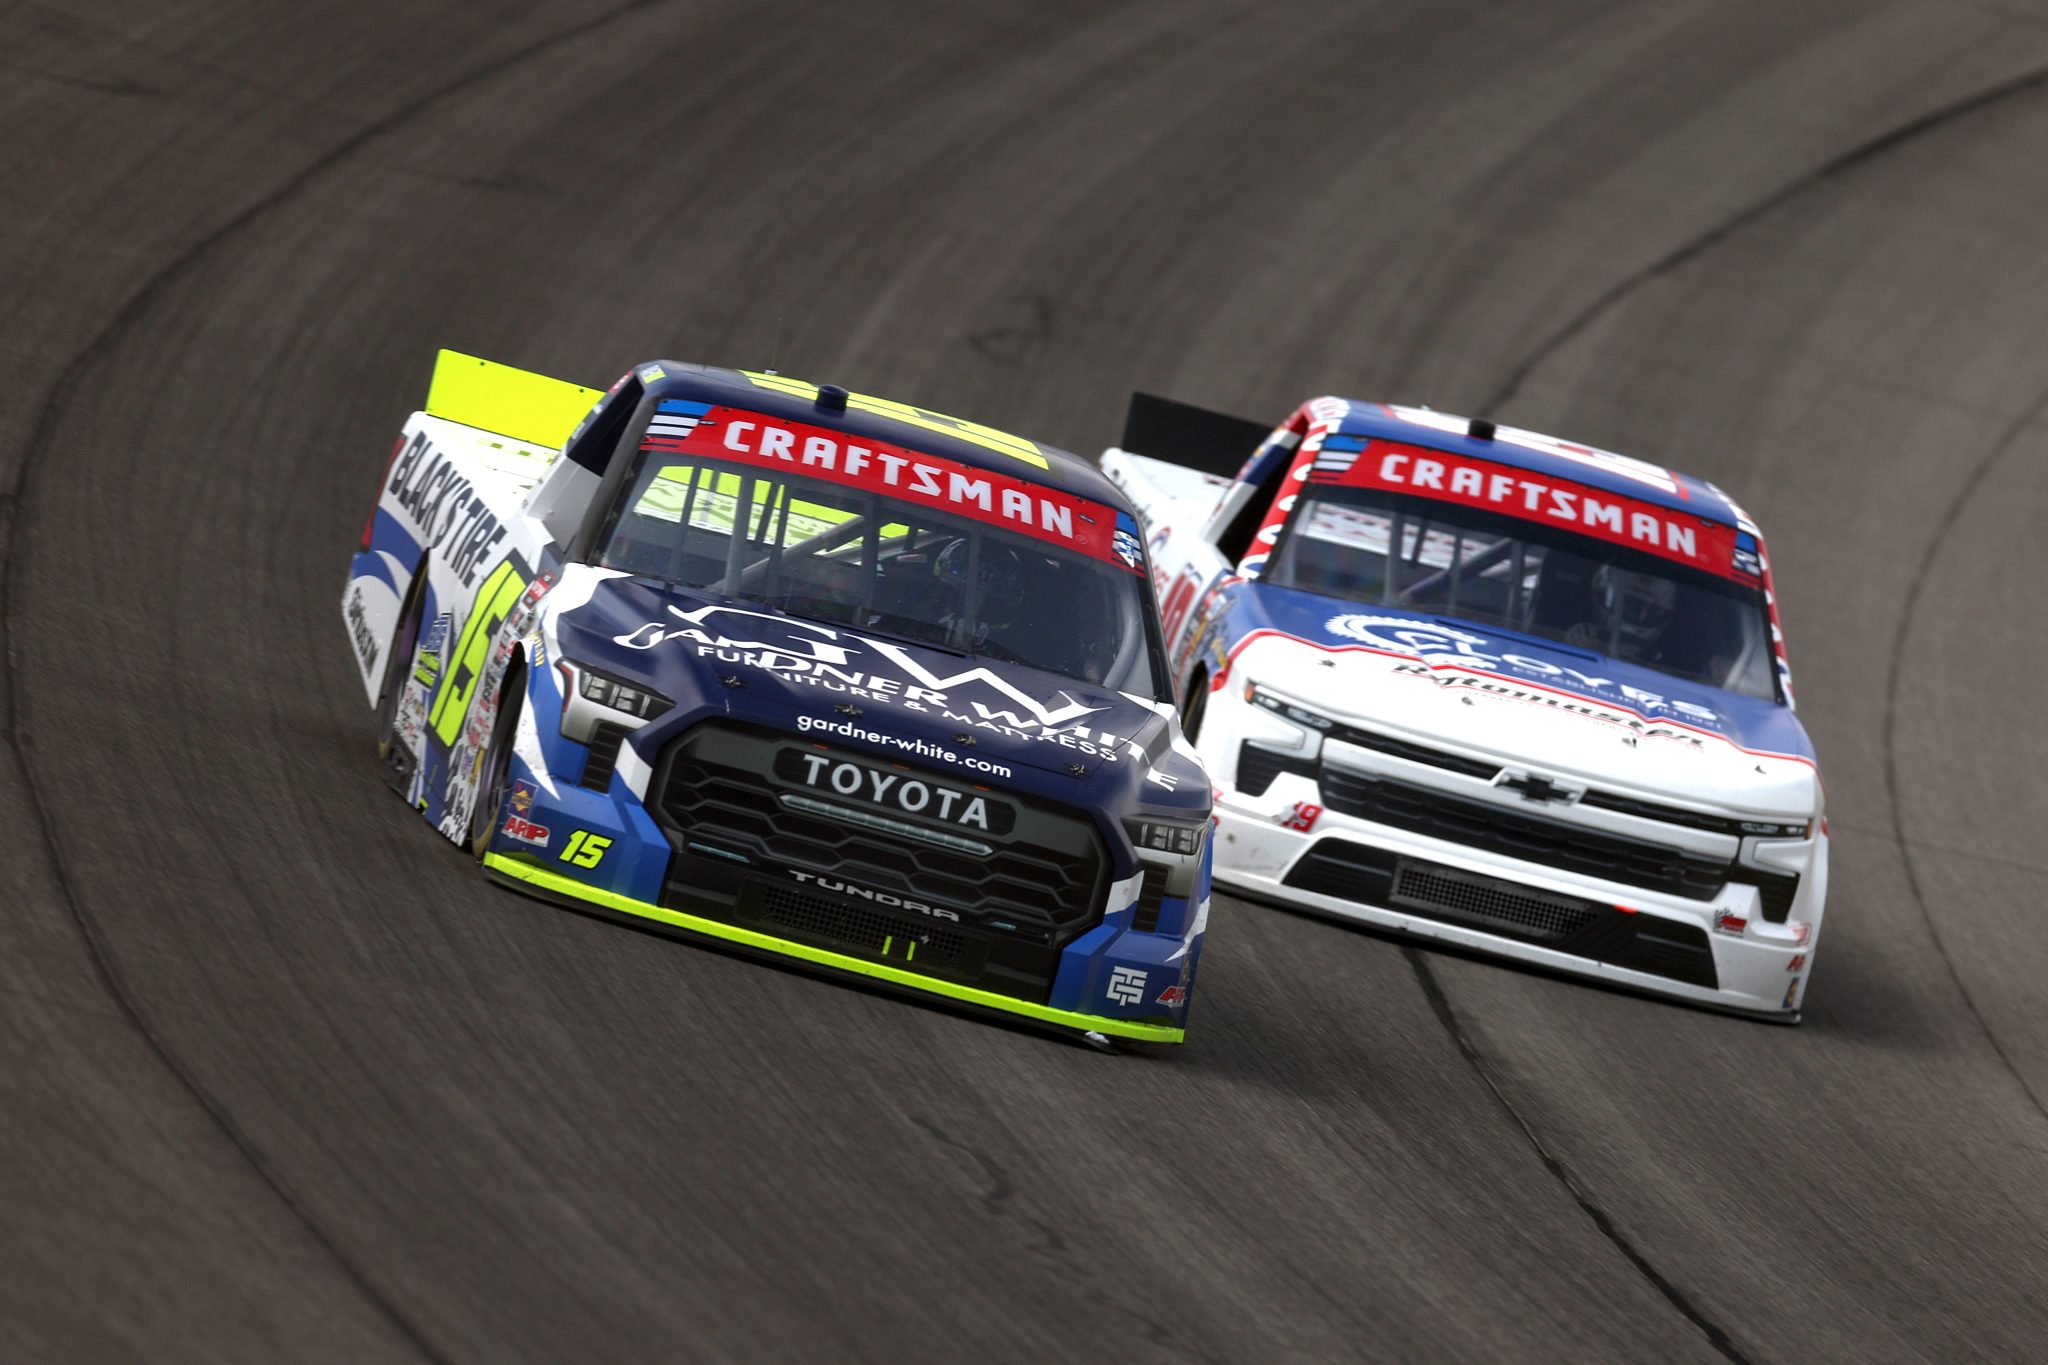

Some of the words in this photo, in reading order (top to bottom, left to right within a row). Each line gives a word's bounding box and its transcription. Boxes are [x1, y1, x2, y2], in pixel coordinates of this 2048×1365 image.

[724, 421, 1073, 539] CRAFTSMAN
[1379, 453, 1697, 559] CRAFTSMAN
[443, 497, 508, 589] TIRE
[697, 646, 891, 703] FURNITURE
[942, 710, 1118, 762] MATTRESS
[797, 715, 1012, 779] gardner-white.com
[503, 817, 549, 840] ARP
[802, 754, 990, 831] TOYOTA
[559, 829, 613, 869] 15
[789, 869, 960, 923] TUNDRA
